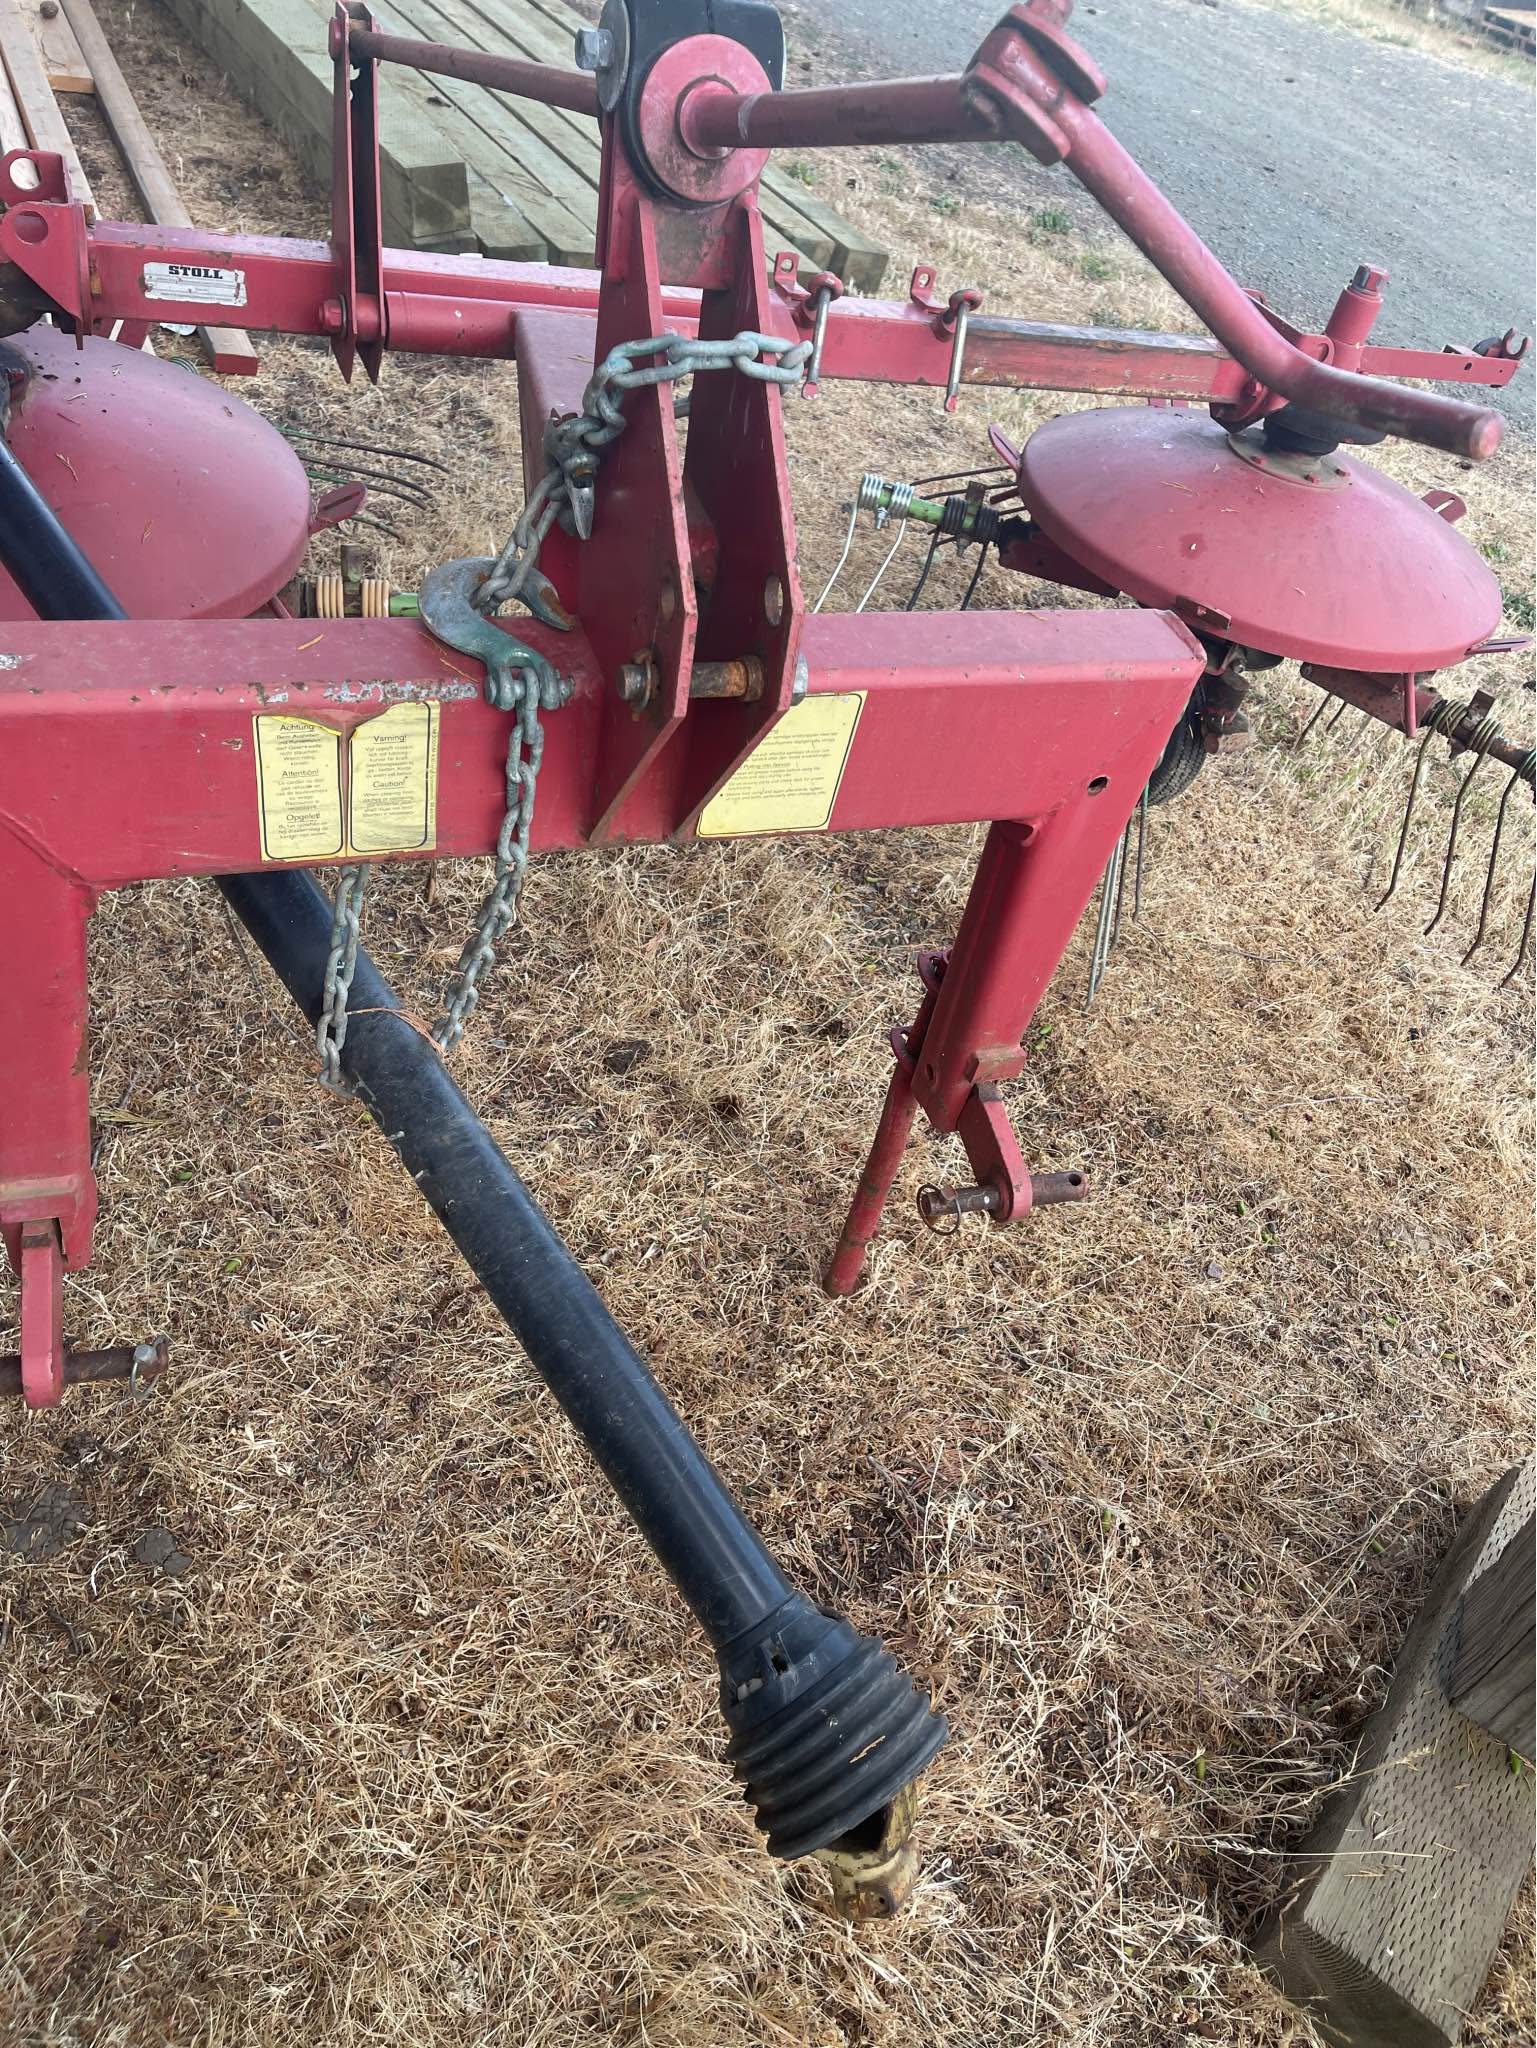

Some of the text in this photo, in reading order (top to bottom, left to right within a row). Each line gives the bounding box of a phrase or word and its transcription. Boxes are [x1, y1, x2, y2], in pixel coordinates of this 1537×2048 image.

[168, 265, 223, 279] STOLL
[373, 734, 407, 743] Varning!
[282, 769, 319, 777] Attention!
